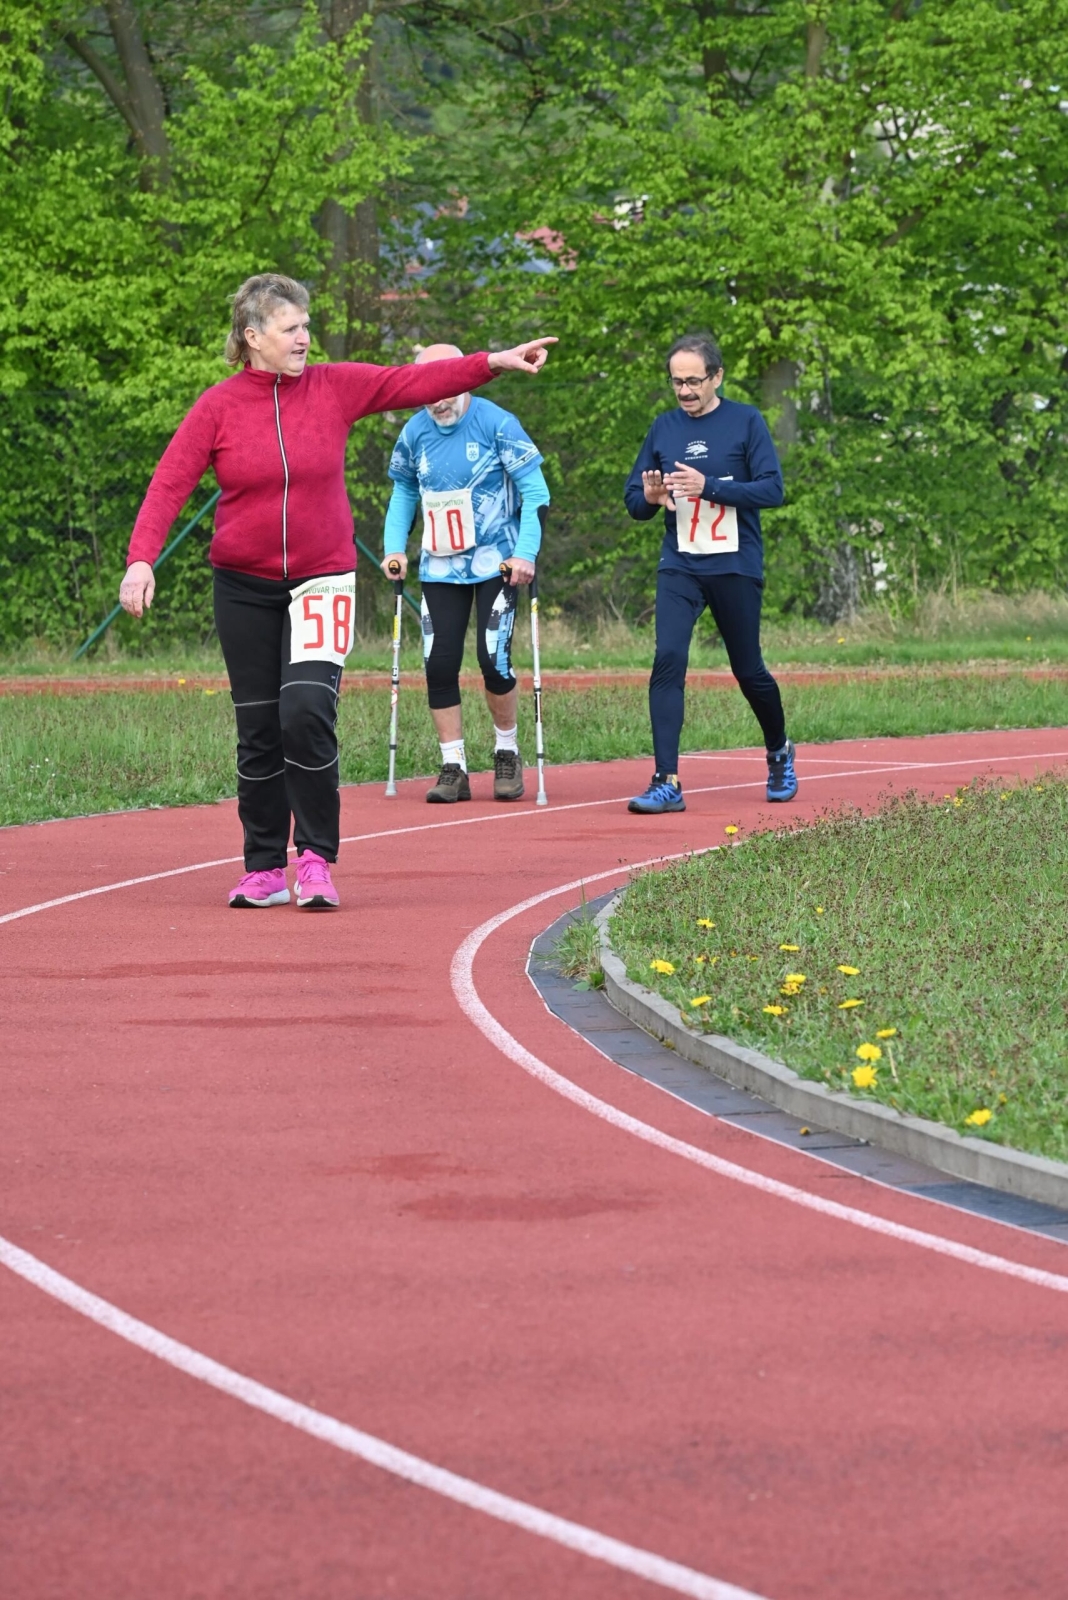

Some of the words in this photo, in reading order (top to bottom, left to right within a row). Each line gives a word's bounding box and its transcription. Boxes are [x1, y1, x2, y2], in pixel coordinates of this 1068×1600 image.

[428, 509, 465, 552] 10
[687, 496, 727, 543] 72
[302, 594, 352, 656] 58
